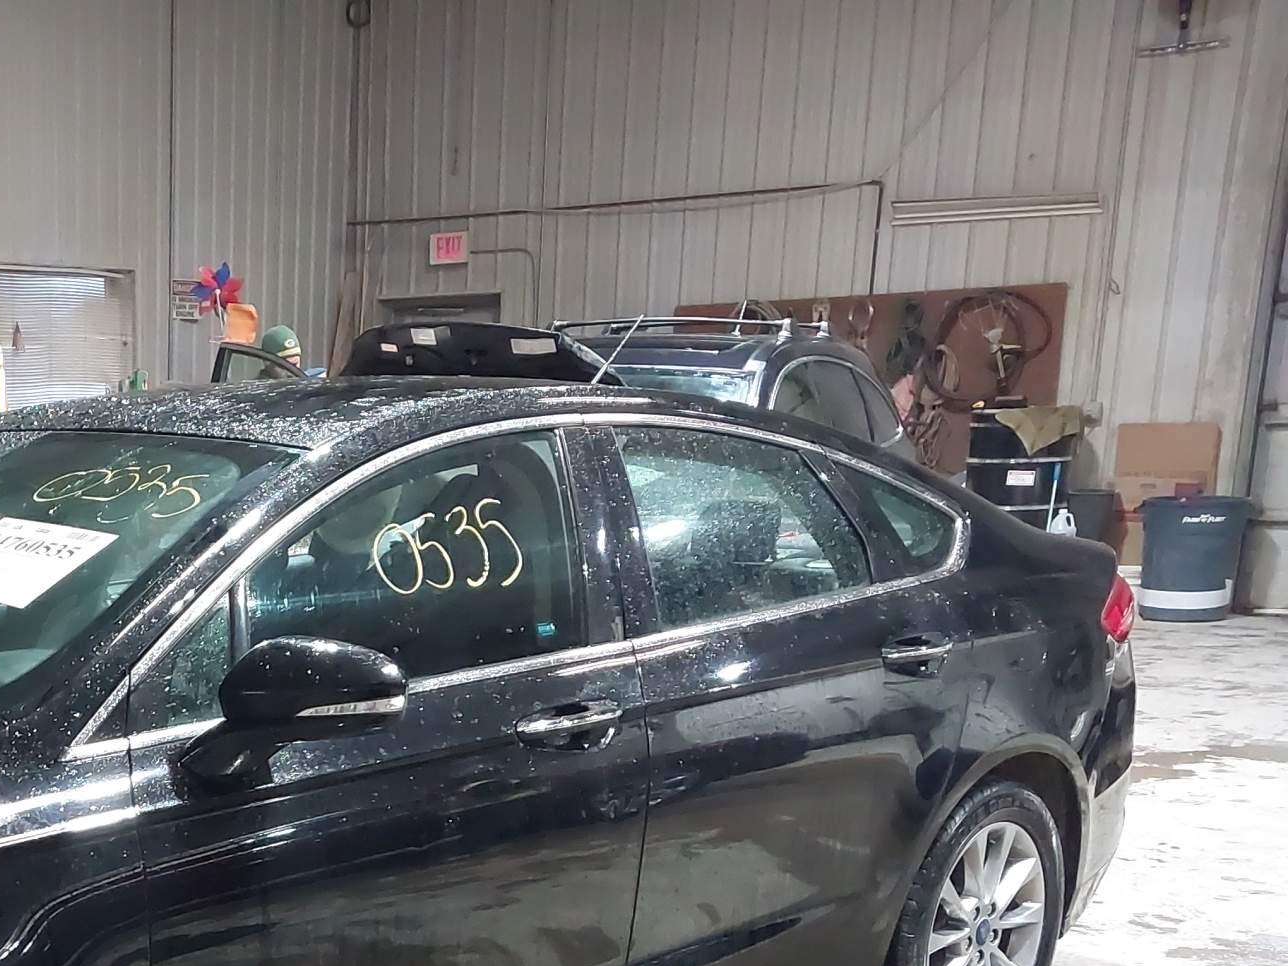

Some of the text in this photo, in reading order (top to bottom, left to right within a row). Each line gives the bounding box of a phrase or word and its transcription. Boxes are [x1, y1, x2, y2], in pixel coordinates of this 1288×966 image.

[436, 236, 462, 258] EXIT
[32, 464, 210, 523] 0535
[373, 498, 523, 594] 0535
